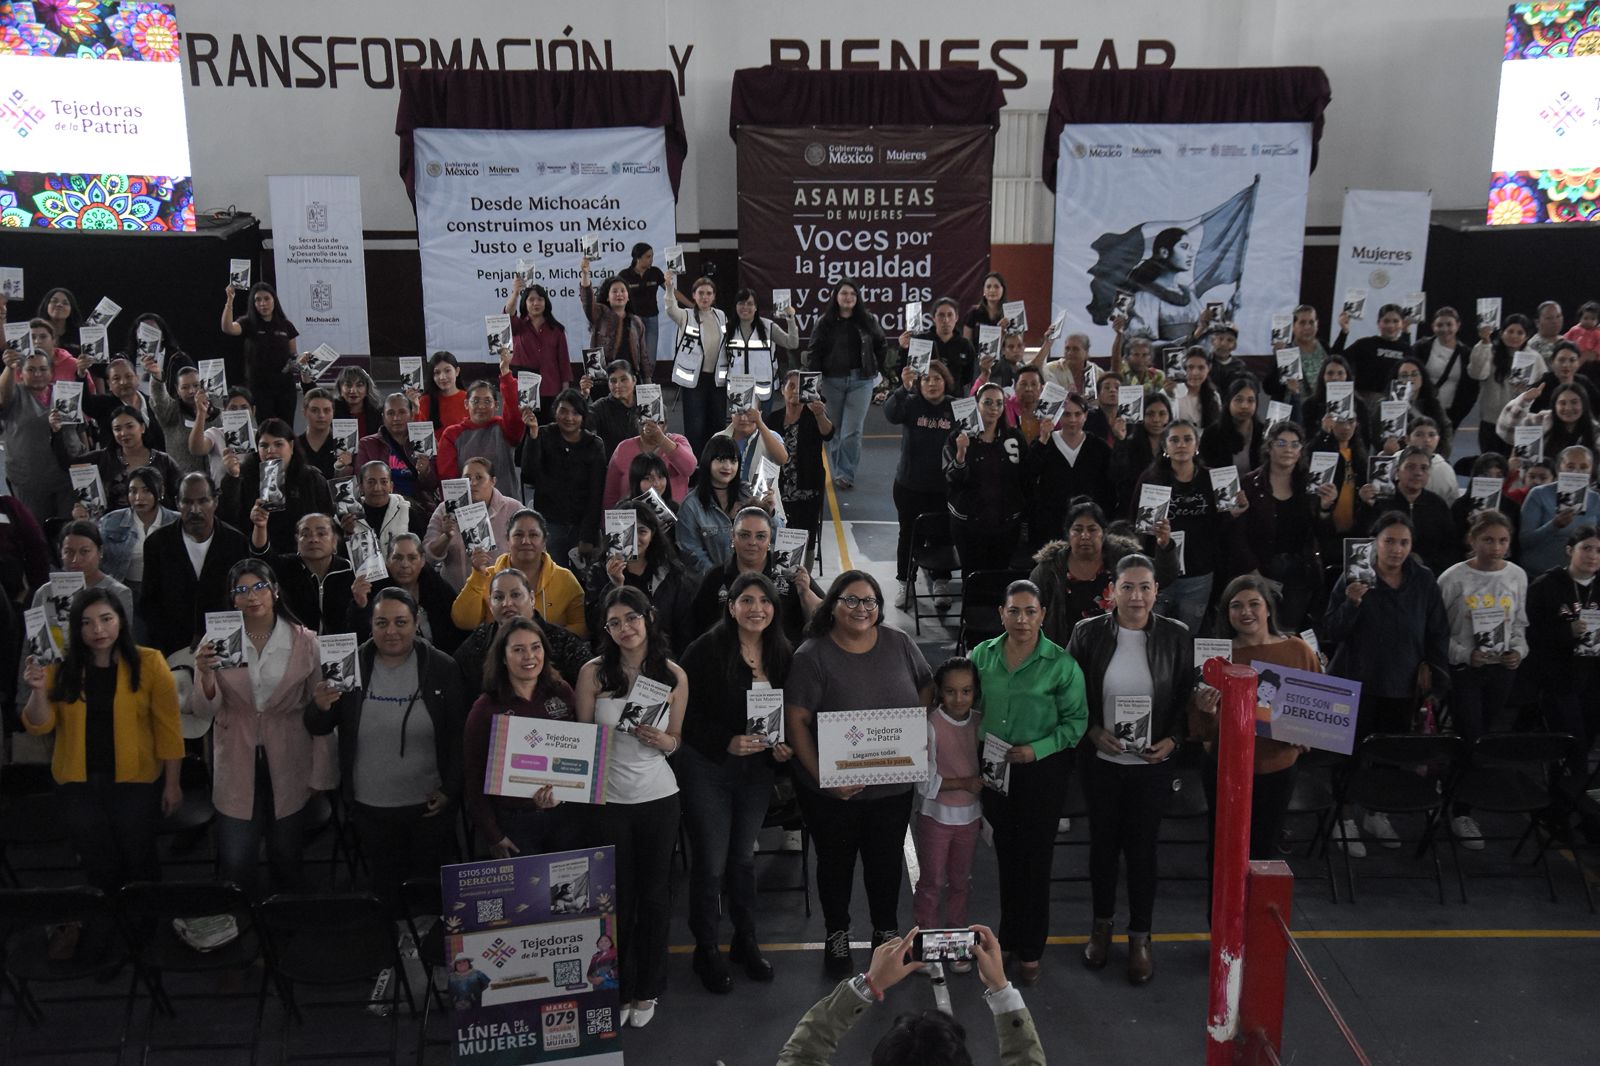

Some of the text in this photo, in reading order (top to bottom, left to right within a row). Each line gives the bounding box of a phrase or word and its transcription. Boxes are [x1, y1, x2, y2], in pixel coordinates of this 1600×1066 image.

[180, 25, 612, 89] RANSFORMACIÓN
[670, 45, 694, 96] Y
[51, 100, 143, 119] Tejedoras
[82, 118, 138, 135] Patria
[829, 152, 874, 164] México
[886, 149, 927, 161] Mujeres
[446, 167, 479, 176] México
[488, 165, 519, 174] Mujeres
[471, 194, 621, 211] Desde Michoacán
[794, 187, 935, 206] ASAMBLEAS
[827, 210, 903, 222] DE MUJERES
[446, 216, 647, 232] construimos un México
[793, 224, 933, 252] Voces por
[471, 238, 625, 257] Justo e Igualirio
[1351, 246, 1413, 261] Mujeres
[795, 254, 931, 285] la igualdad
[495, 287, 508, 298] 18
[560, 287, 575, 298] de
[796, 288, 810, 308] y
[901, 282, 932, 302] las
[305, 315, 339, 323] Michoacán
[1286, 693, 1311, 706] ESTOS
[1312, 698, 1330, 710] SON
[1282, 704, 1351, 728] DERECHOS
[546, 733, 581, 743] Tejedoras
[866, 726, 903, 736] Tejedoras
[877, 733, 900, 741] Patria
[555, 741, 578, 750] Patria
[459, 869, 480, 878] ESTOS
[481, 867, 497, 876] SON
[459, 873, 515, 887] DERECHOS
[520, 934, 583, 950] Tejedoras
[521, 952, 530, 960] de
[540, 944, 579, 958] Patria
[545, 1003, 573, 1011] MARCA
[514, 1019, 524, 1027] DE
[545, 1011, 575, 1027] 079
[458, 1022, 511, 1041] LÍNEA
[514, 1026, 529, 1034] LAS
[458, 1033, 537, 1056] MUJERES
[546, 1037, 576, 1047] MUJERES
